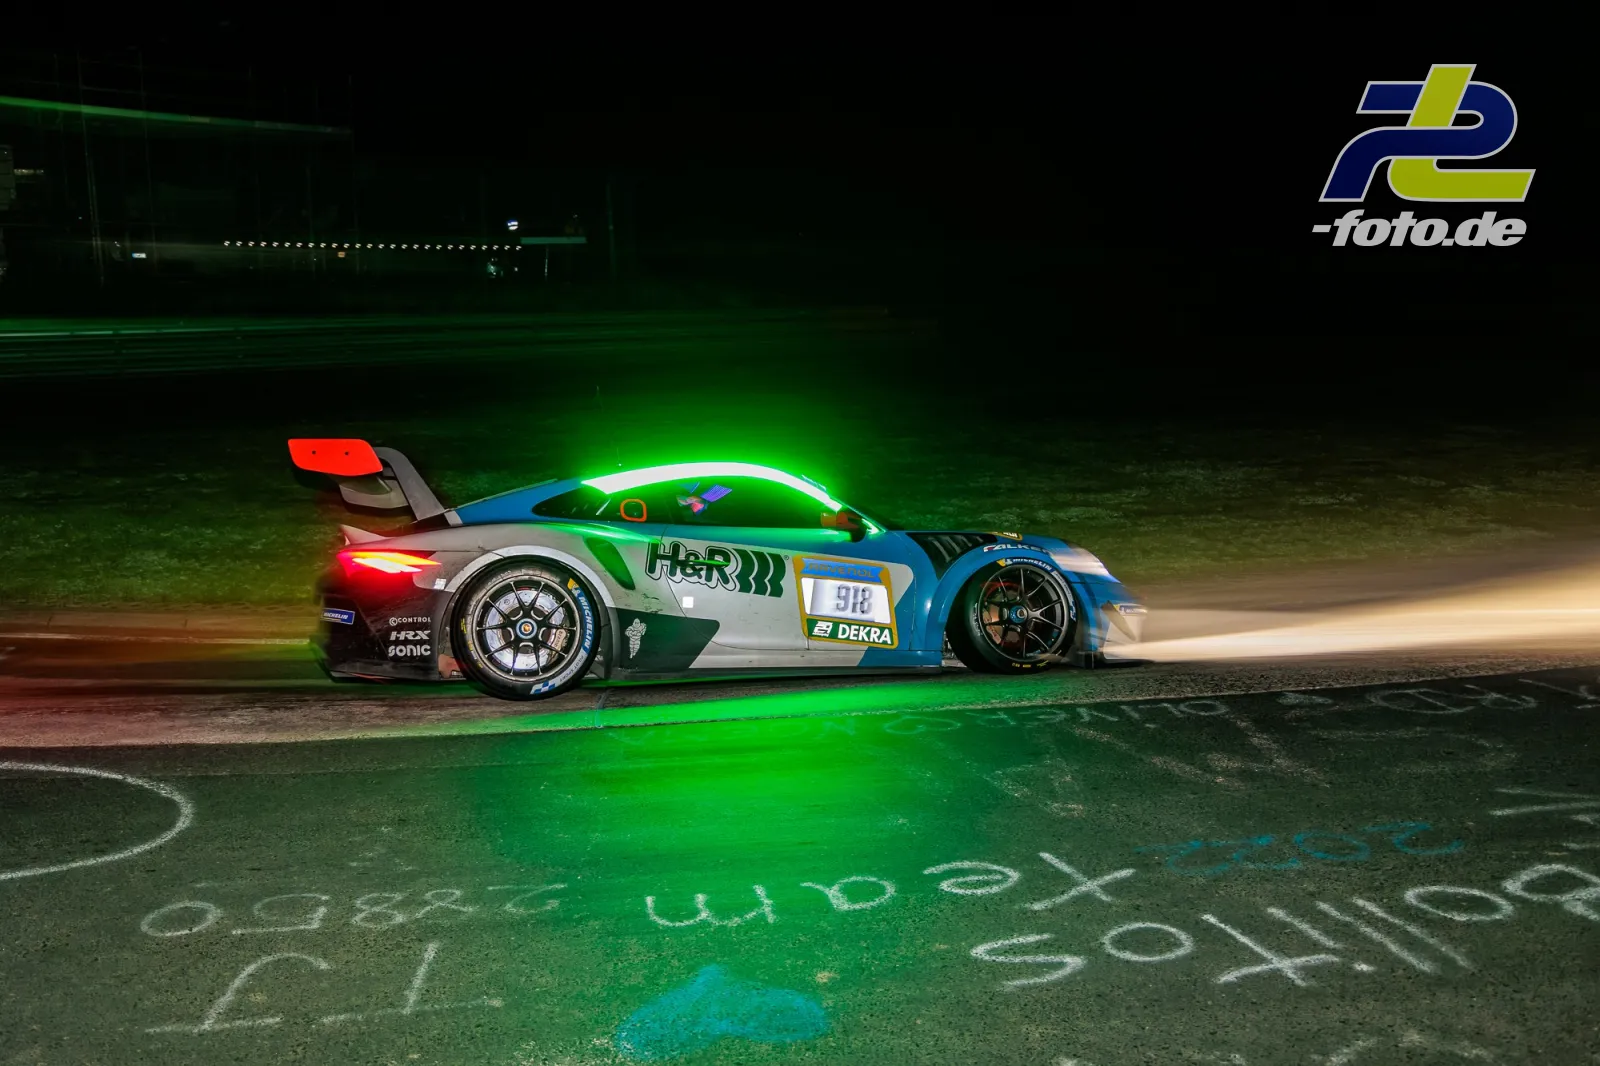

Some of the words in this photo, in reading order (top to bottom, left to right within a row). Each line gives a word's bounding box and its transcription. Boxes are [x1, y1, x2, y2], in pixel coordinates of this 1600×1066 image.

[645, 540, 738, 591] H&R
[808, 562, 875, 579] RAVENOL
[835, 584, 873, 614] 918
[577, 596, 593, 649] MICHELIN
[837, 624, 892, 645] DEKRA
[1136, 822, 1463, 877] 2022
